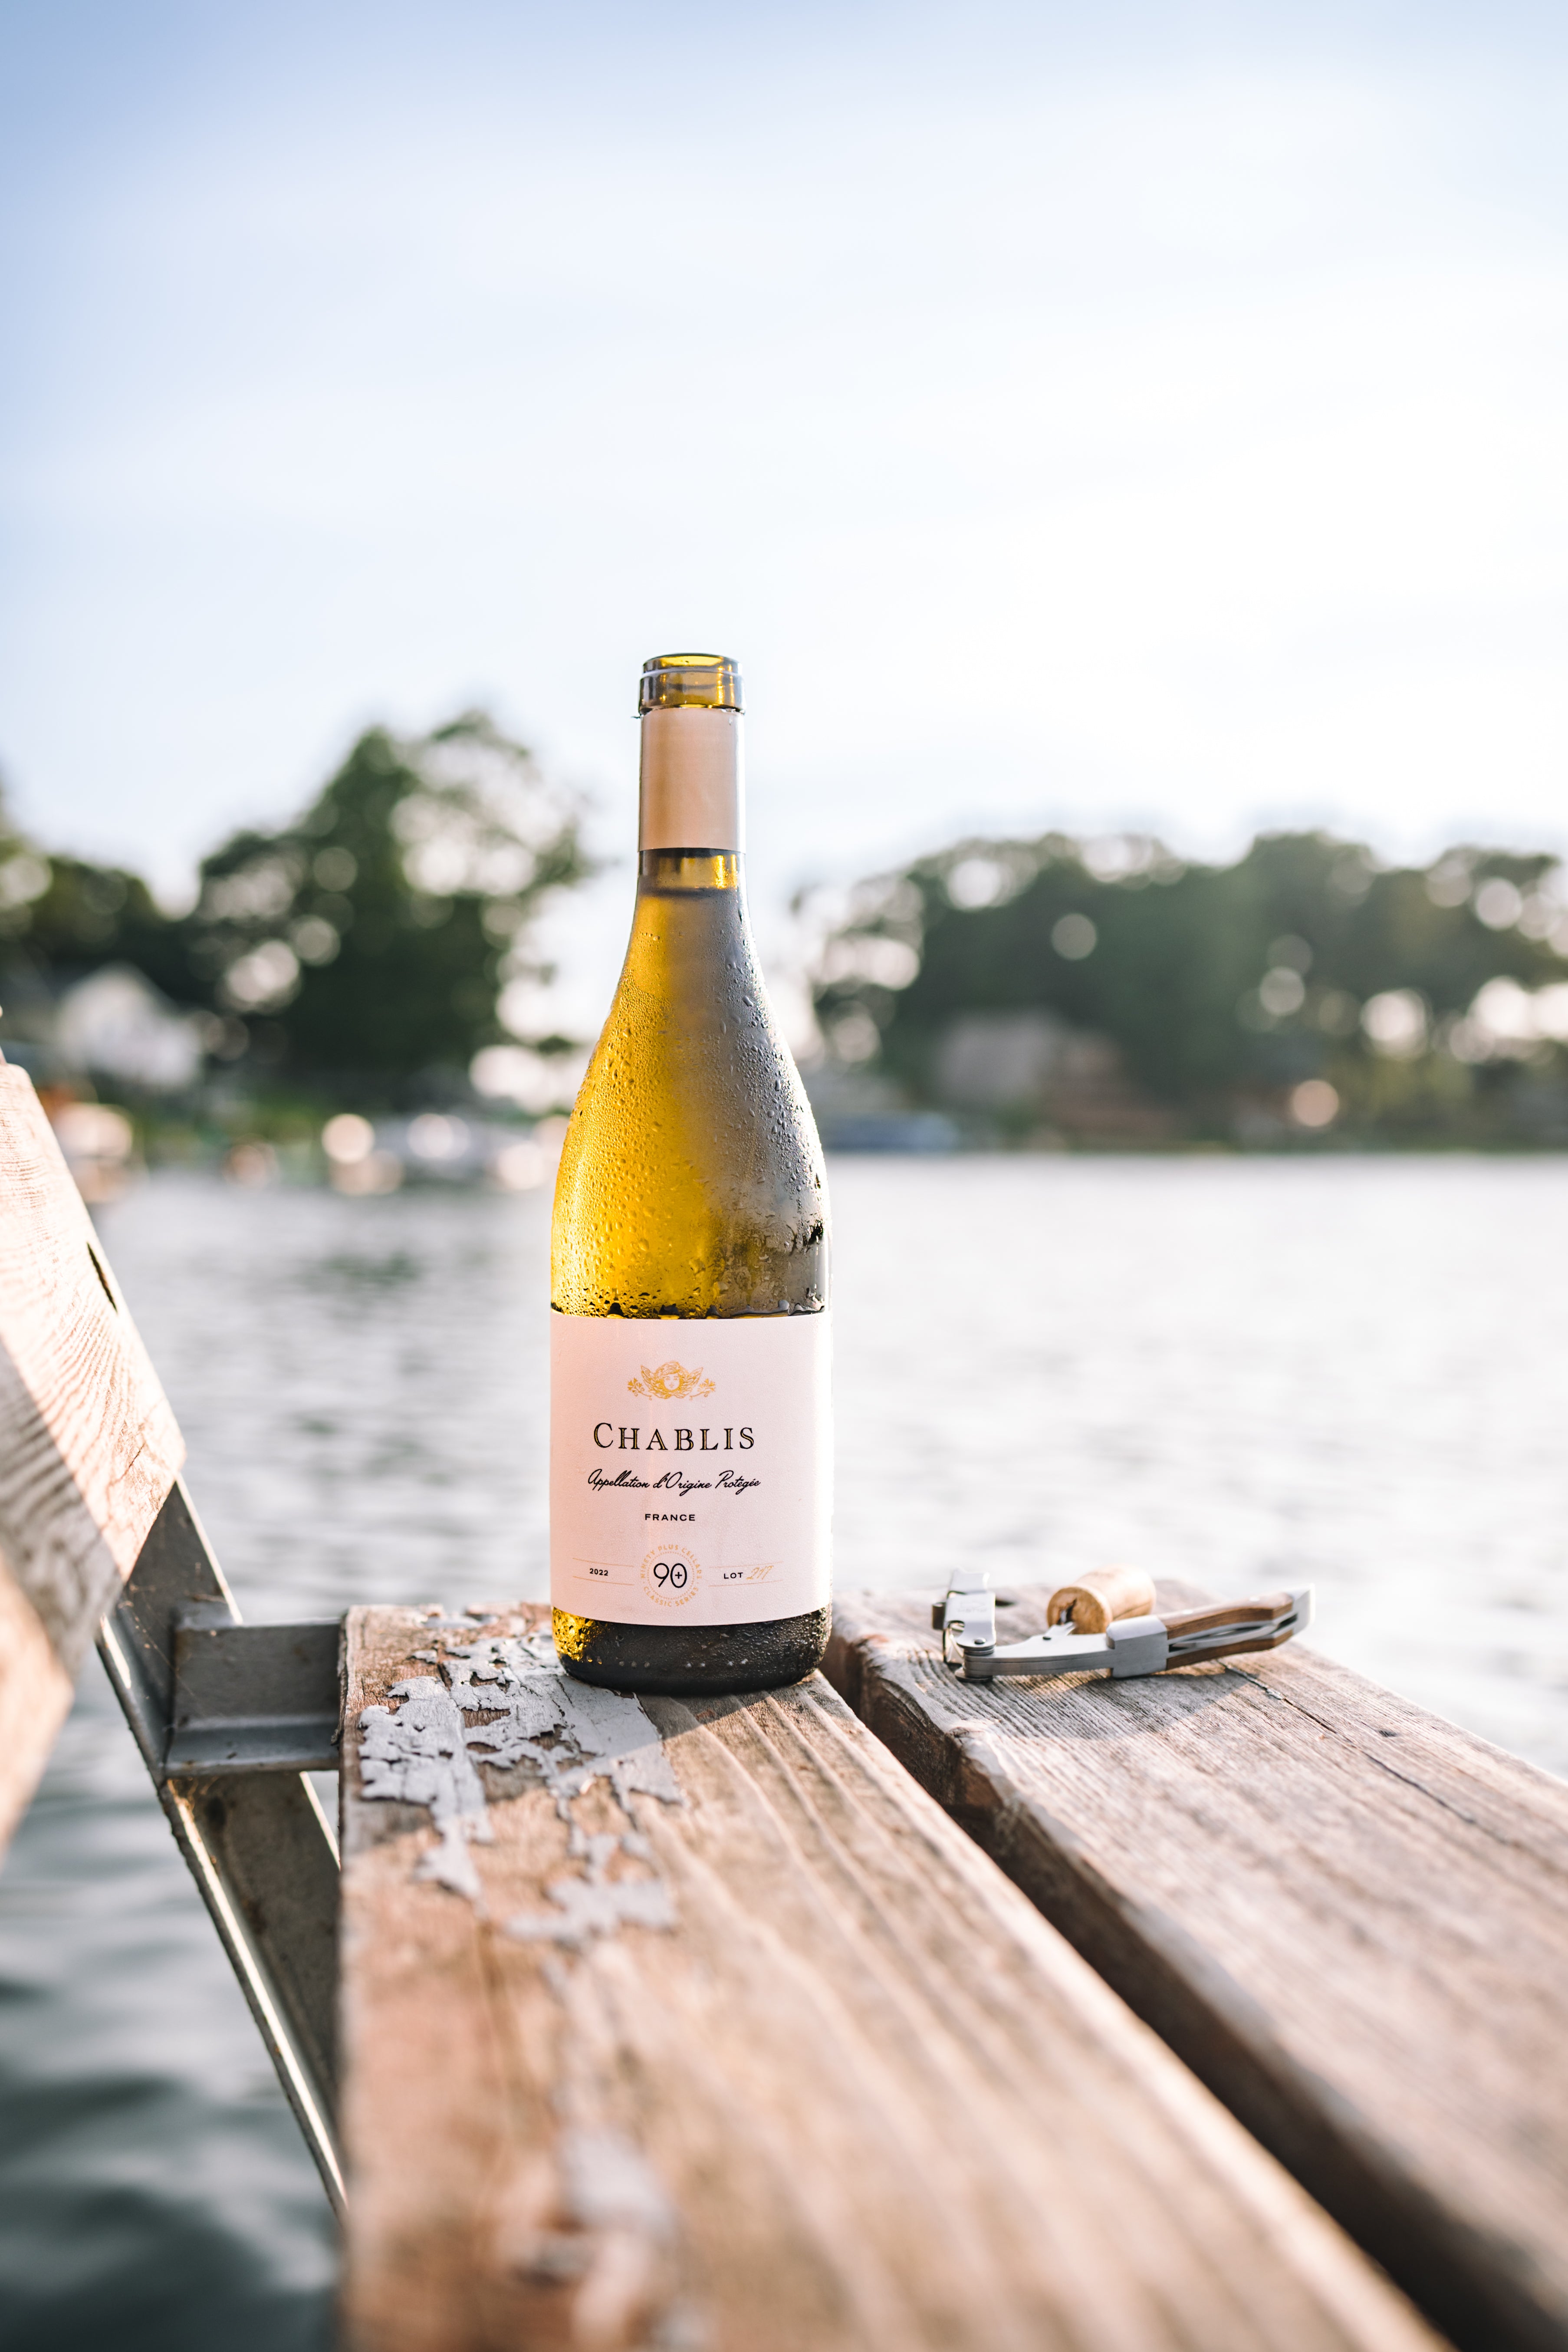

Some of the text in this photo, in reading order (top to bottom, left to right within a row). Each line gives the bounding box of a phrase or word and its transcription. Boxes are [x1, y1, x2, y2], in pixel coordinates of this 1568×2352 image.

[594, 1422, 754, 1451] CHABLIS
[588, 1468, 650, 1491] Appellation
[652, 1471, 712, 1497] d'Origine
[641, 1549, 655, 1579] NINETY
[681, 1547, 702, 1579] CELLARS
[644, 1586, 699, 1607] CLASSIC SERIES
